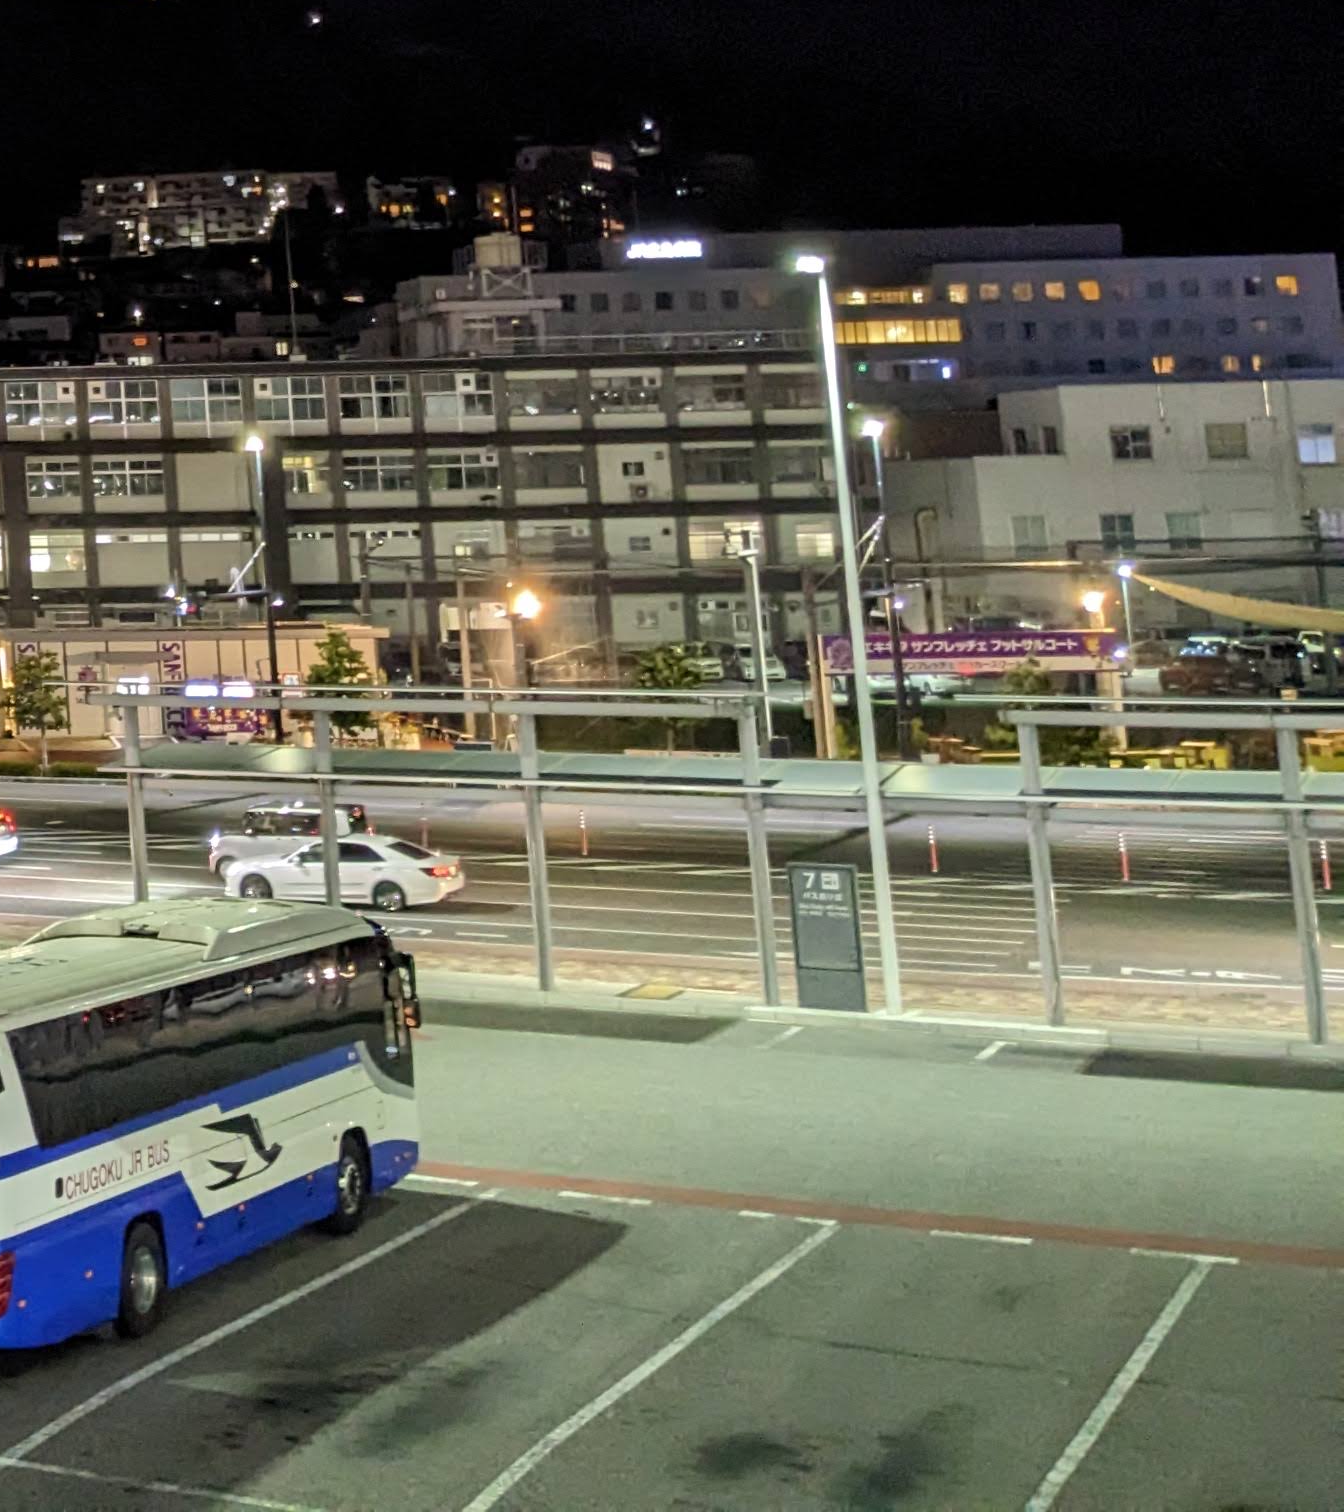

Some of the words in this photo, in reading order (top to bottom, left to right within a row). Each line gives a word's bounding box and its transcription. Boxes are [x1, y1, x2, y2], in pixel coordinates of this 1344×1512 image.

[802, 872, 815, 889] 7
[65, 1157, 123, 1200] CHUGOKU
[128, 1149, 143, 1176] JR
[147, 1139, 170, 1169] BUS
